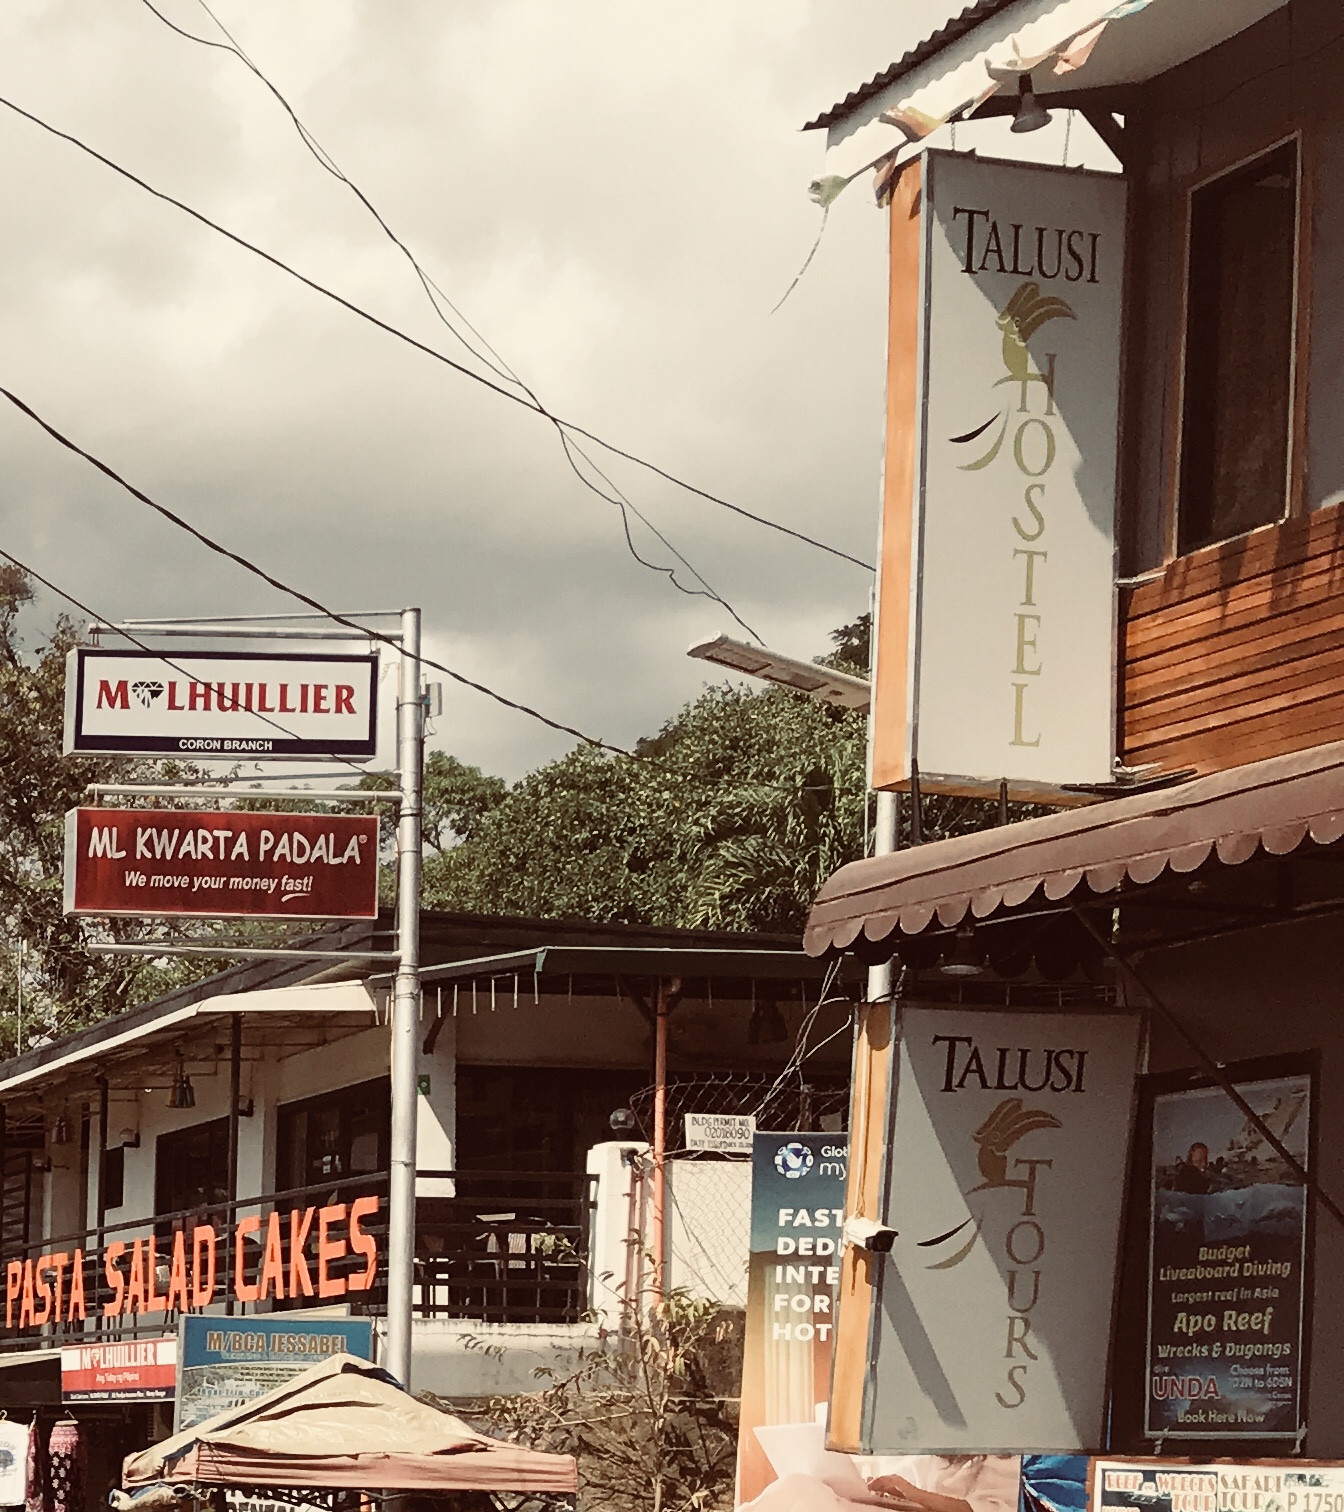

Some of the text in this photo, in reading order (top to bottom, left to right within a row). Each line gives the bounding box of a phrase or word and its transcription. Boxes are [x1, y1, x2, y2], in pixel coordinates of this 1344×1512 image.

[953, 207, 1102, 284] TALUSI
[1010, 352, 1057, 748] HOSTEL
[179, 739, 273, 751] CORON BRANCH
[88, 827, 362, 865] ML KWARTA PADALA
[125, 871, 313, 893] We move your money fast!
[932, 1035, 1088, 1093] TALUSI
[6, 1195, 379, 1329] PASTA SALAD CAKES
[1199, 1245, 1250, 1262] Budget
[1159, 1260, 1291, 1280] Liveaboard Diving
[994, 1158, 1053, 1409] TOURS
[773, 1295, 830, 1313] FOR
[1172, 1286, 1279, 1304] Largest reef in Asia
[1174, 1306, 1274, 1336] Apo Reef
[207, 1331, 348, 1353] M/BCA JESSABEL
[1158, 1343, 1209, 1358] Wrecks
[1225, 1343, 1291, 1359] Dugongs
[1208, 1410, 1236, 1423] Here
[1237, 1410, 1266, 1423] Now
[1220, 1474, 1281, 1493] SAFARI
[1221, 1491, 1265, 1510] TOUR
